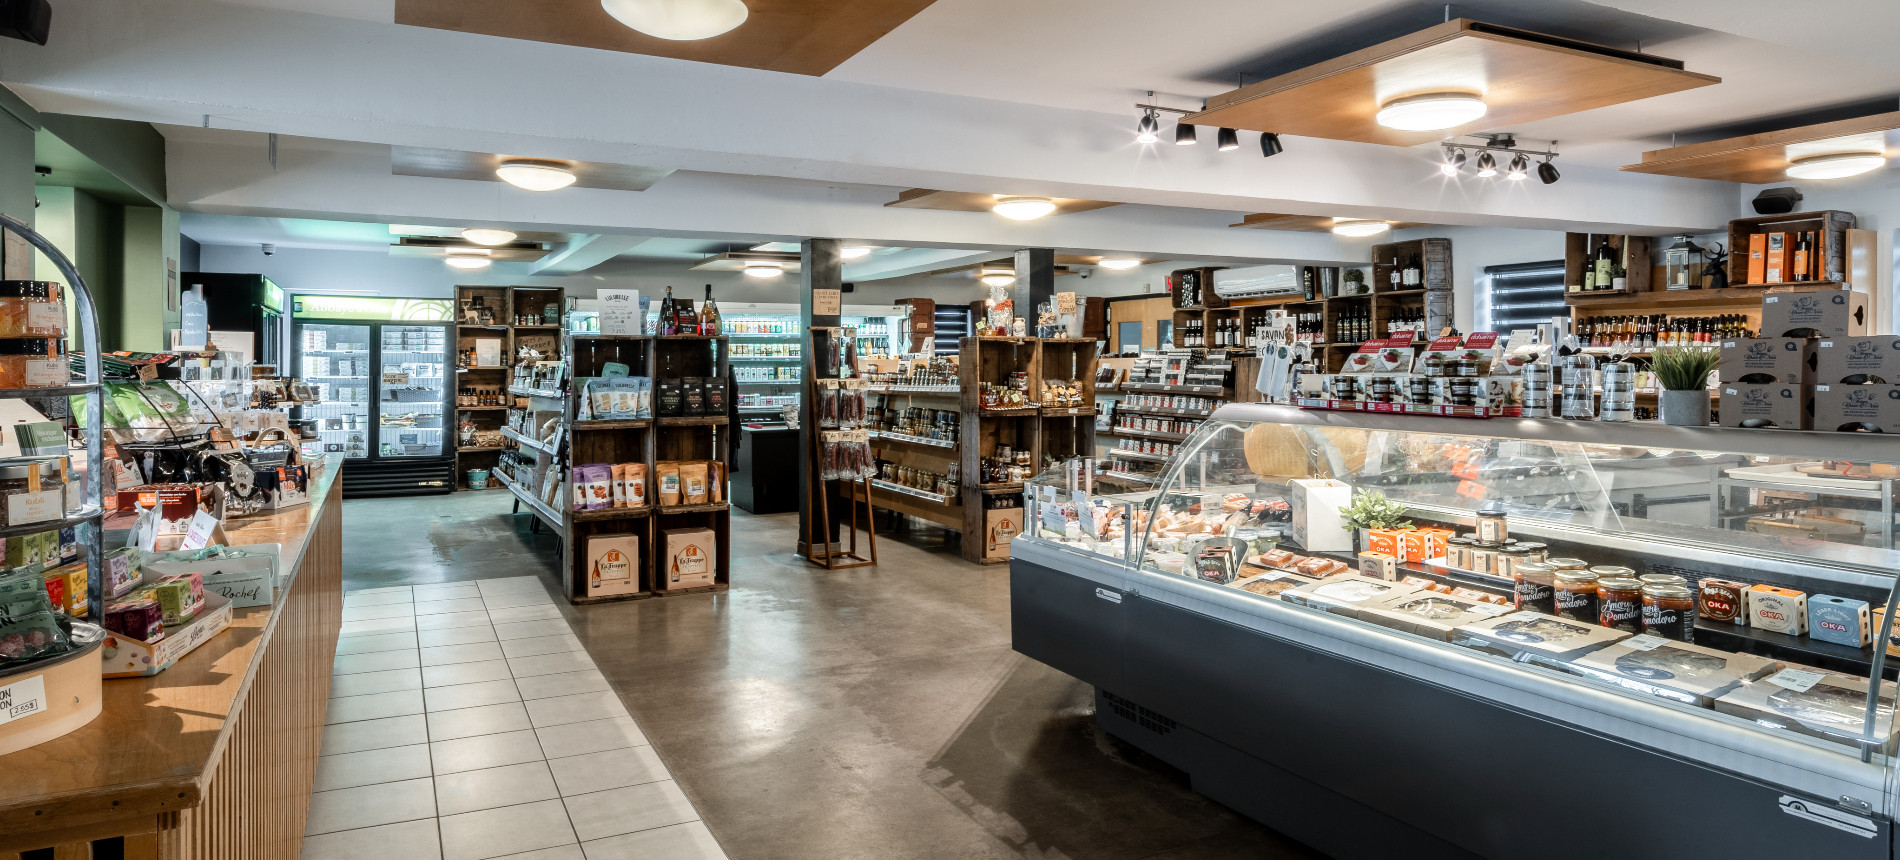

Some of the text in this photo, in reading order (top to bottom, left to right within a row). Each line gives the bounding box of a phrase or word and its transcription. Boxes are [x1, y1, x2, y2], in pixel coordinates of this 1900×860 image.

[216, 585, 261, 601] Rochef
[1707, 600, 1731, 611] OKA
[1757, 596, 1784, 608] ORIGINAL
[1759, 609, 1785, 622] OKA
[1820, 620, 1848, 633] OKA
